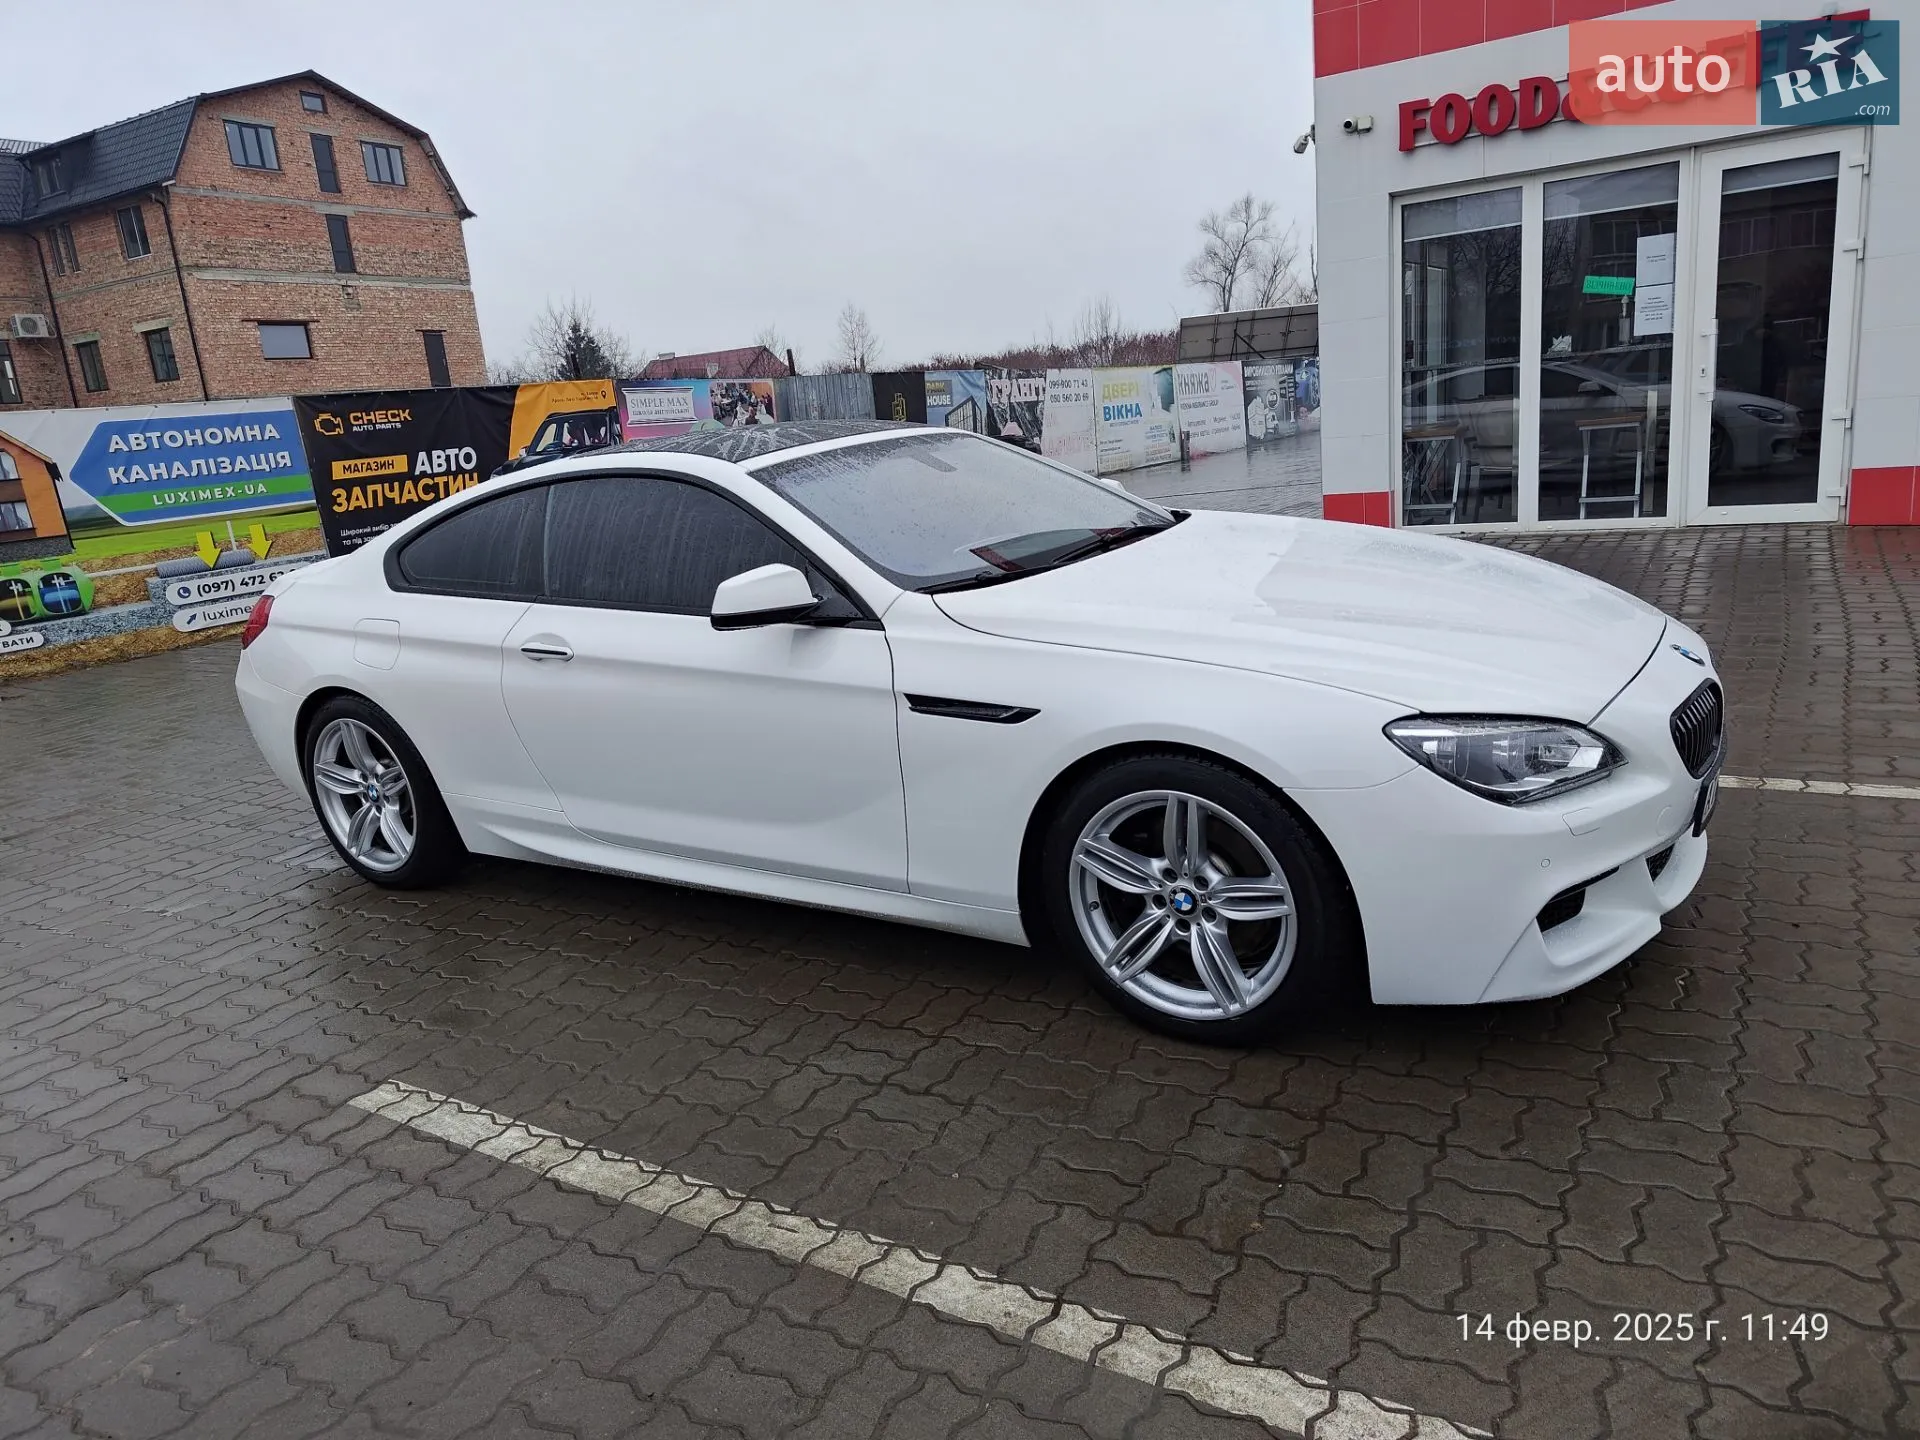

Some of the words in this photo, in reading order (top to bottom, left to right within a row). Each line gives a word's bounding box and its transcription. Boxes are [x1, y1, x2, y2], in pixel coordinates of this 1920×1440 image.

[926, 395, 951, 406] HOUSE
[990, 378, 1046, 404] ГРАНІТ
[1102, 383, 1140, 402] ДВЕРІ
[630, 398, 665, 409] SIMPLE
[667, 396, 689, 407] MAX
[349, 408, 412, 425] CHECK
[1103, 403, 1143, 422] ВІКНА
[375, 422, 402, 430] PARTS
[108, 423, 281, 454] АВТОНОМНА
[107, 451, 293, 486] КАНАЛІЗАЦІЯ
[342, 461, 396, 475] МАГАЗИН
[414, 446, 478, 476] АВТО
[152, 483, 269, 507] LUXIMEX-UA
[340, 525, 372, 537] Широкий
[196, 579, 236, 598] (097)
[239, 575, 267, 588] 472
[202, 604, 255, 622] luxime
[0, 637, 35, 648] ВАТИ
